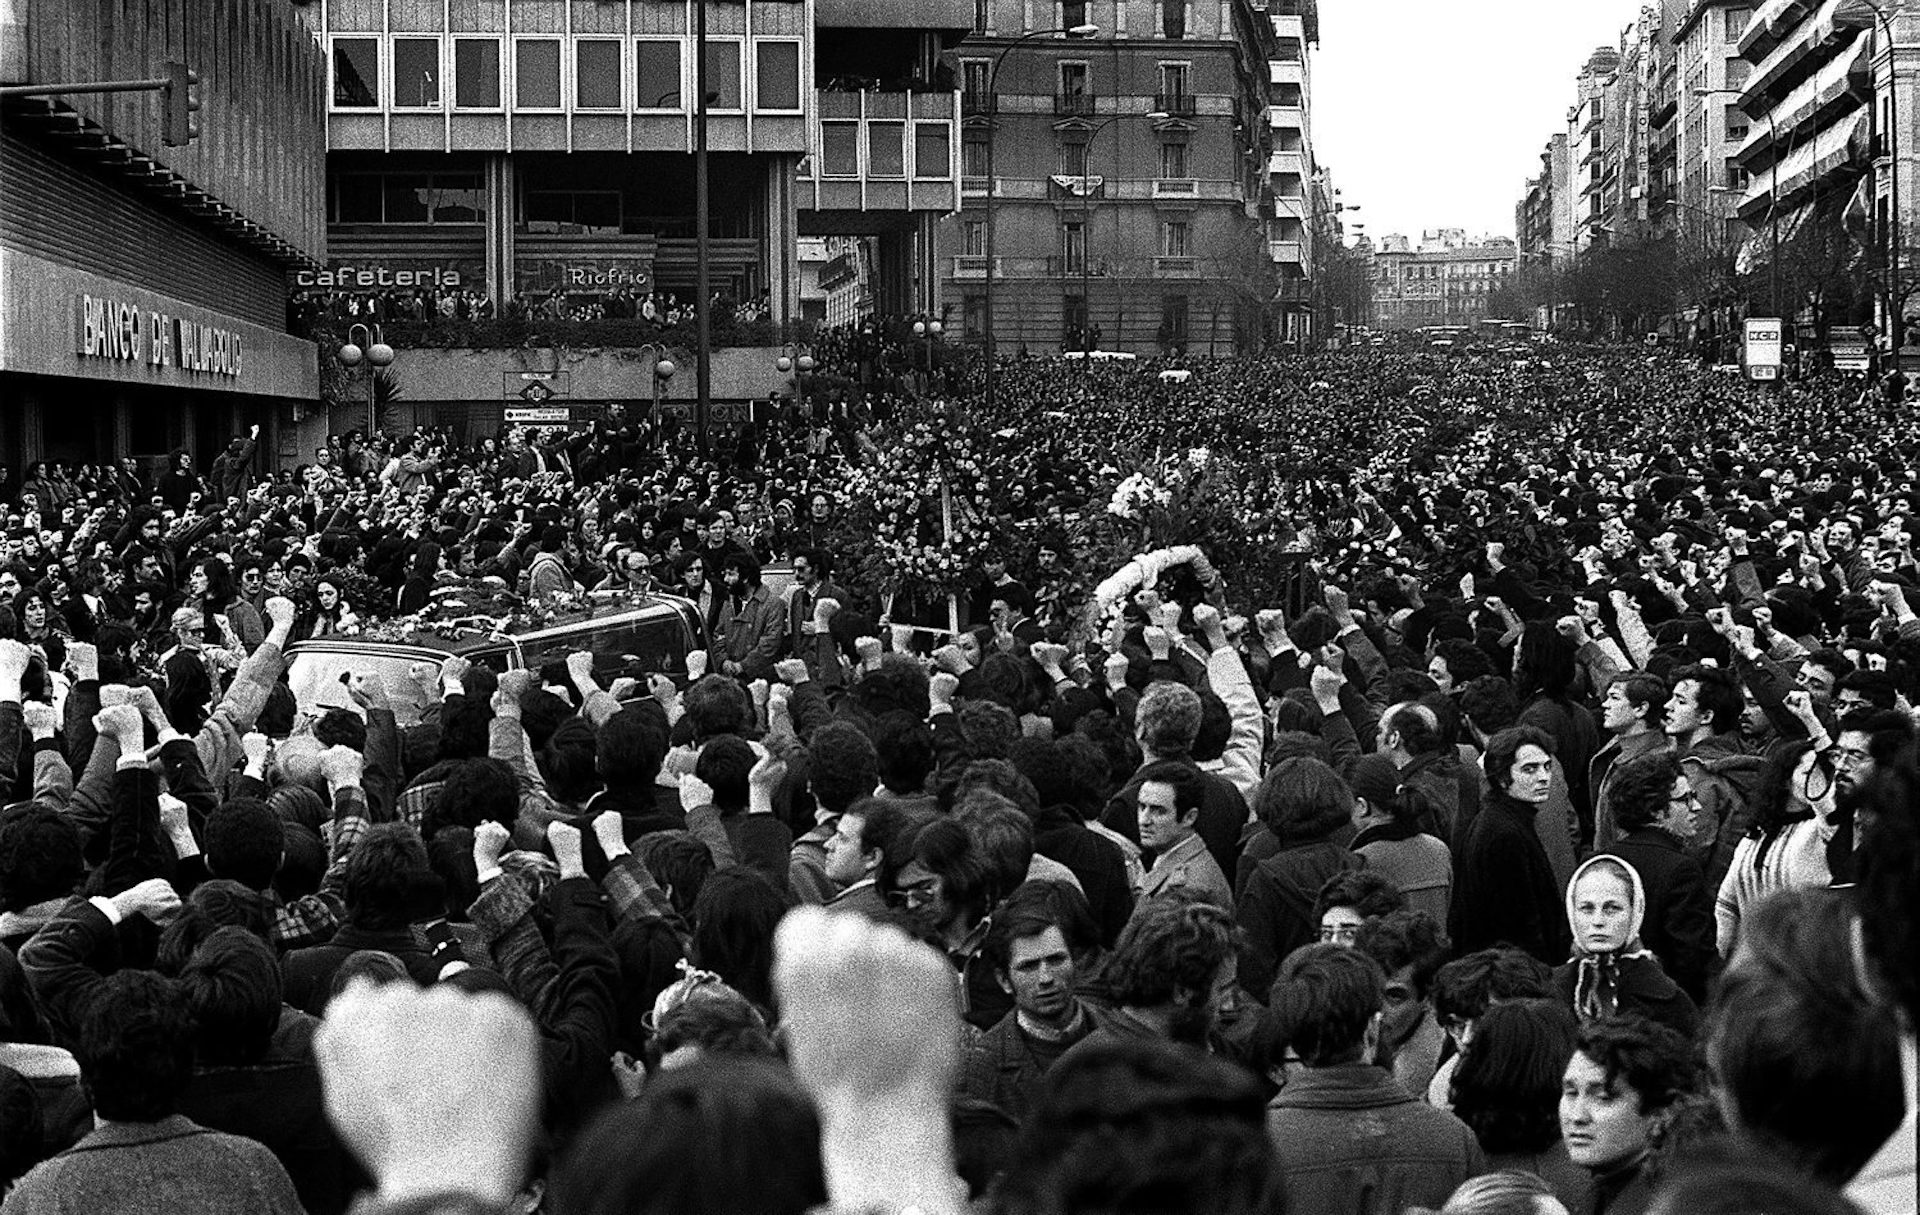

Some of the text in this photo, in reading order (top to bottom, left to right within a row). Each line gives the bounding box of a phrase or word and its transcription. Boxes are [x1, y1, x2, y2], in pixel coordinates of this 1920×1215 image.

[297, 267, 460, 286] cafeteria
[82, 294, 140, 360] BANCO
[152, 312, 170, 365] DE
[1749, 331, 1778, 341] NCR
